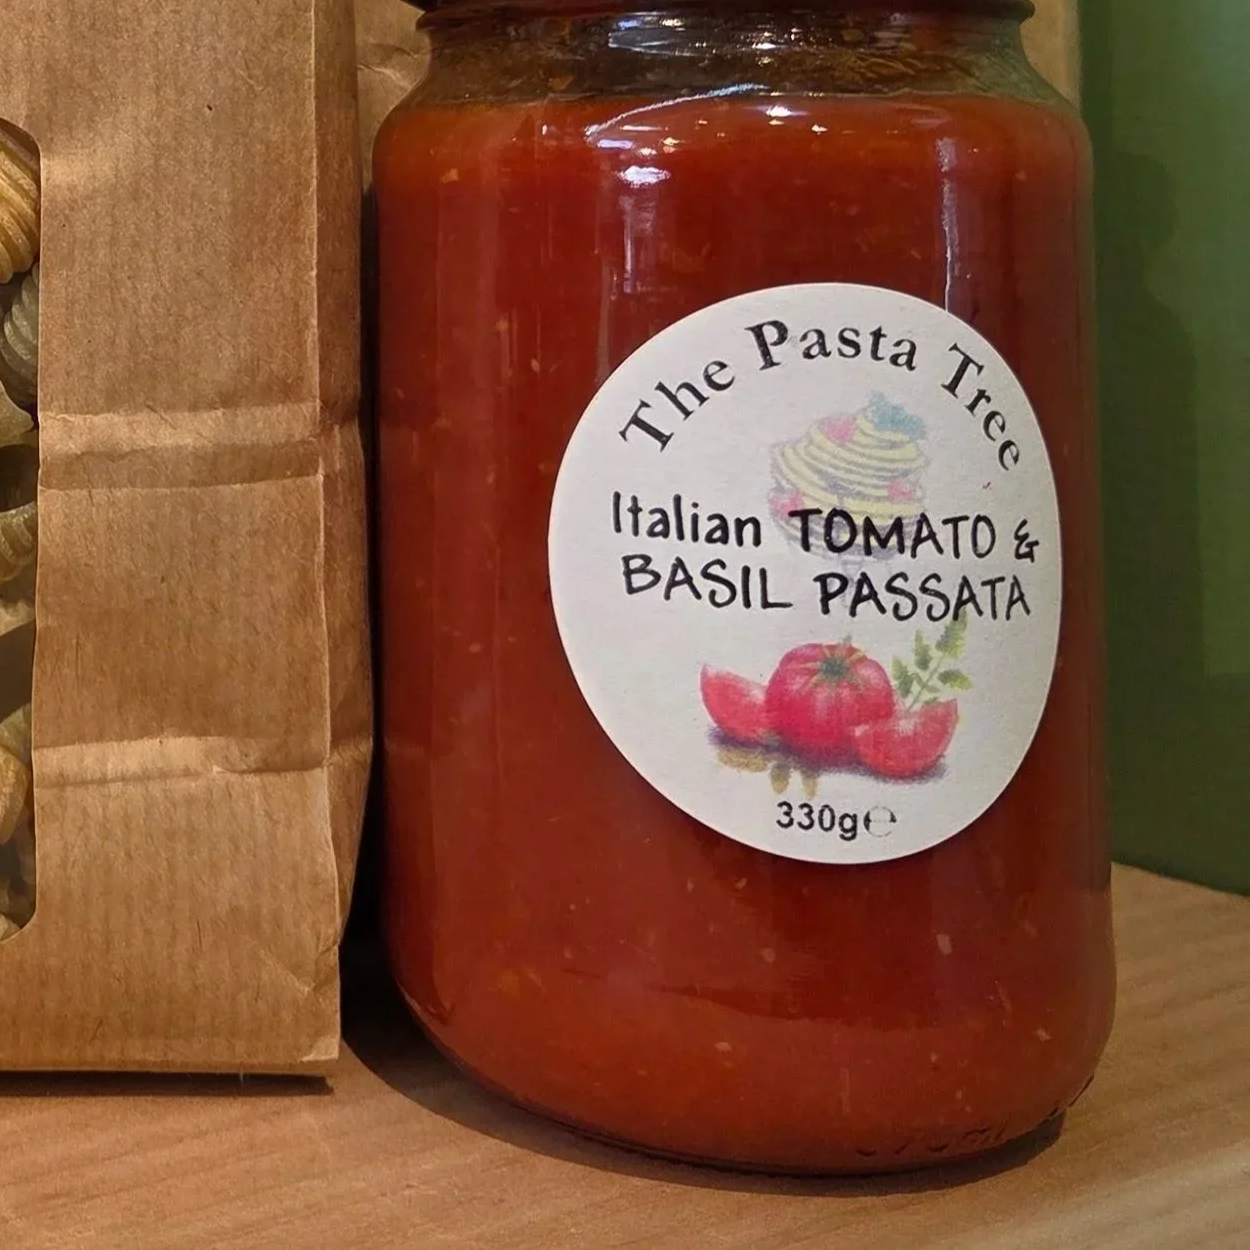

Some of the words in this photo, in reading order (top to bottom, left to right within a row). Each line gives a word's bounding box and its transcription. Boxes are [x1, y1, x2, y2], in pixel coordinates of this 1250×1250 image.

[619, 358, 735, 451] The
[744, 319, 917, 371] Pasta
[940, 343, 1020, 471] Tree
[612, 491, 761, 546] Italian
[788, 508, 996, 558] TOMATO
[1014, 519, 1040, 563] &
[622, 553, 791, 610] BASIL
[814, 572, 1031, 621] PASSATA
